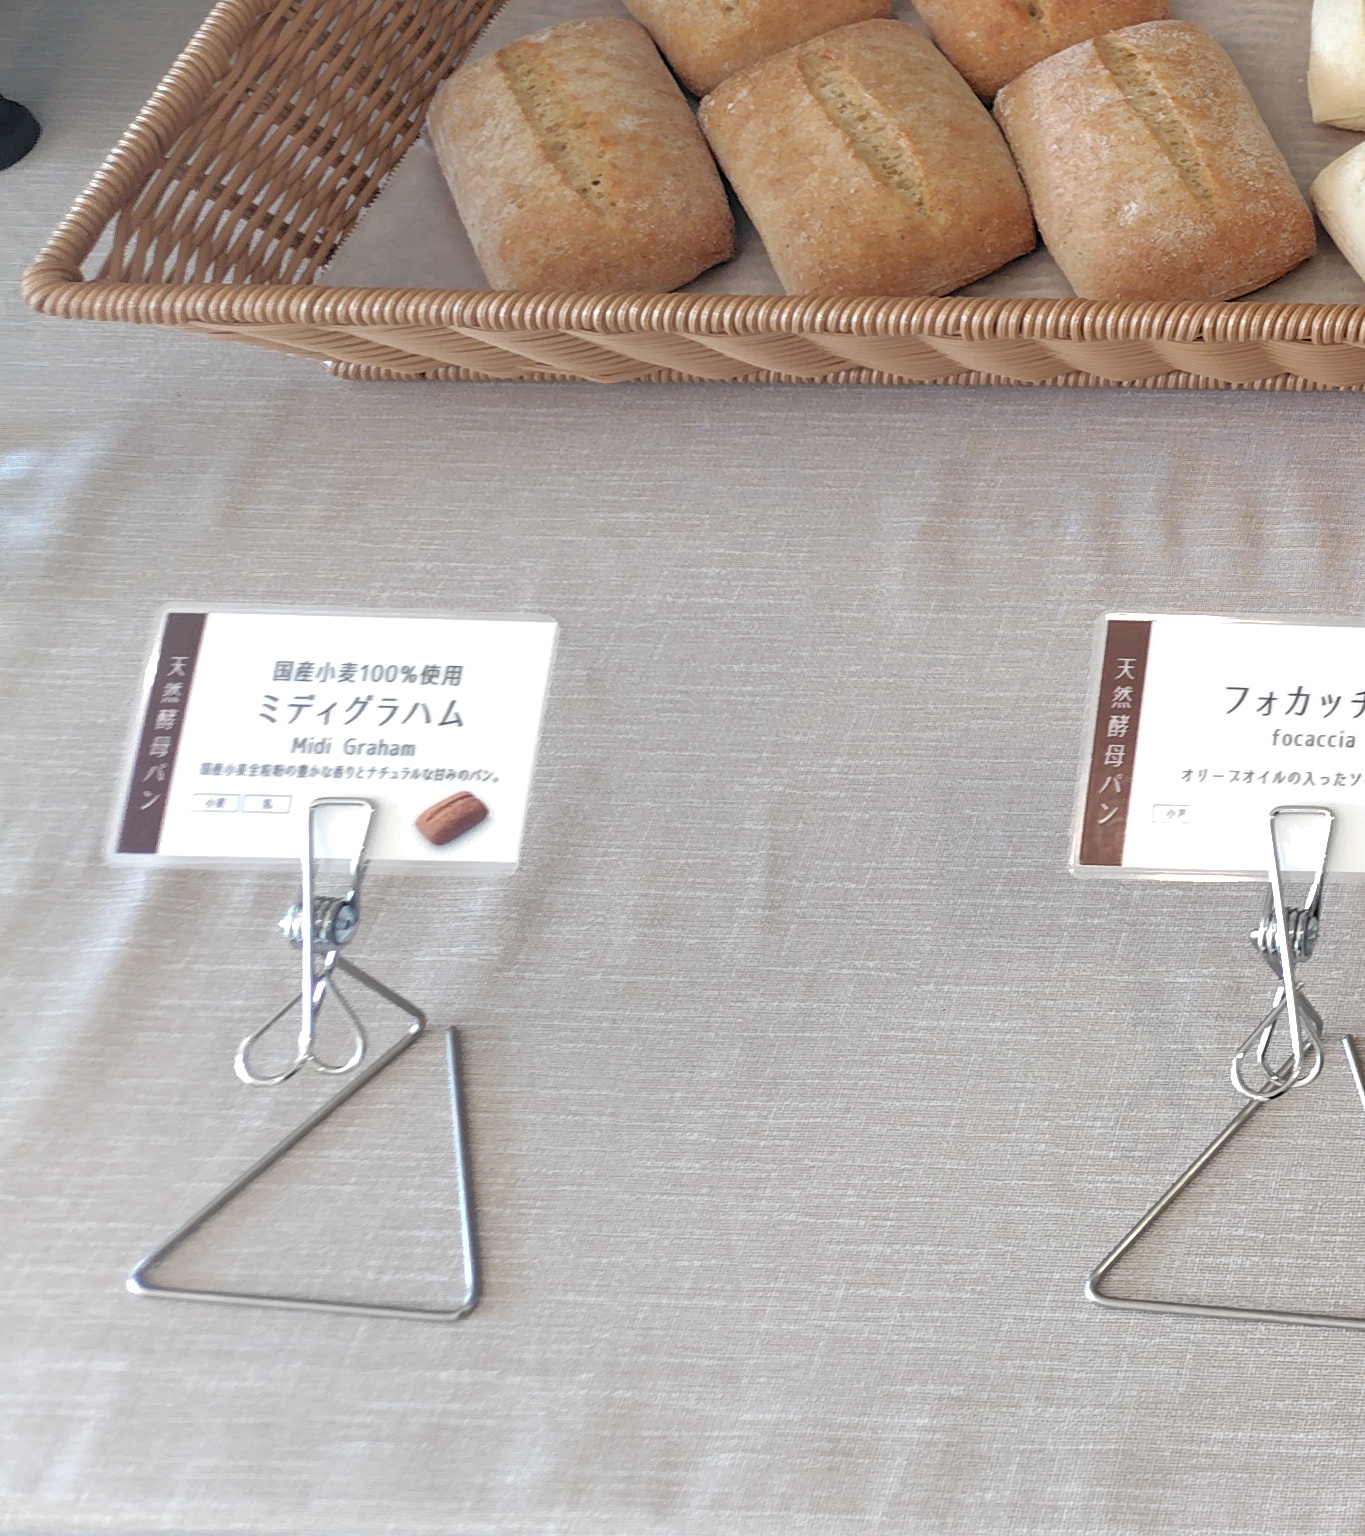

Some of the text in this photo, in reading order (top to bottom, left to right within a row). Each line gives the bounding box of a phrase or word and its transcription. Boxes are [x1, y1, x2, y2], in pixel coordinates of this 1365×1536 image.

[273, 661, 463, 686] 国産小麦100%使用
[259, 695, 463, 727] ミディグラハム
[140, 656, 190, 810] 天然酵母パン
[291, 737, 415, 756] Midi Graham
[1098, 658, 1136, 824] 天然酵母パン
[1273, 729, 1355, 748] focaccia
